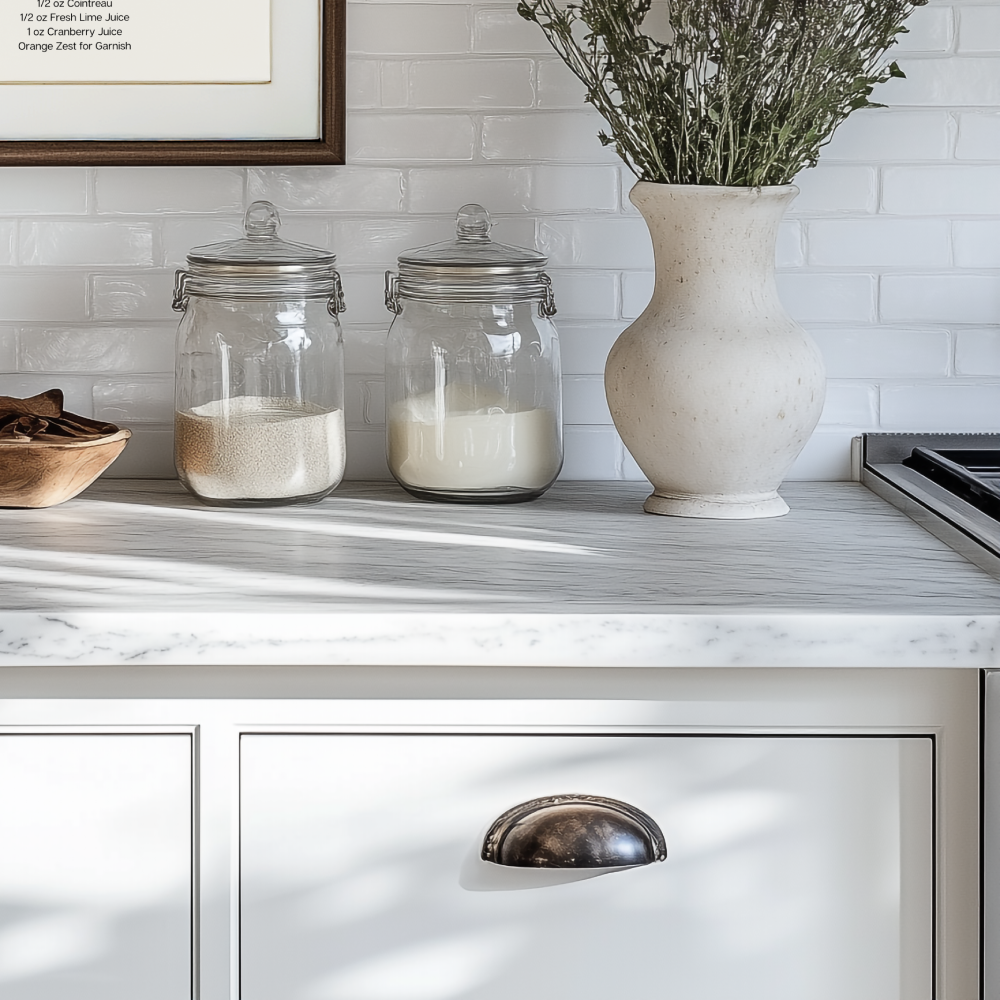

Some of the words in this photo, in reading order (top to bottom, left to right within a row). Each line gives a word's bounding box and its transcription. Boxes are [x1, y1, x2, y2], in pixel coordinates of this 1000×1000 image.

[53, 0, 65, 8] oz
[19, 12, 34, 22] 1/2
[36, 14, 48, 22] oz
[49, 12, 77, 22] Fresh
[79, 12, 103, 22] Lime
[104, 12, 131, 22] Juice
[26, 27, 31, 37] 1
[33, 28, 45, 37] oz
[46, 26, 96, 38] Cranberry
[97, 26, 123, 37] Juice
[17, 41, 54, 53] Orange
[55, 41, 77, 51] Zest
[79, 41, 93, 51] for
[95, 41, 132, 51] Garnish
